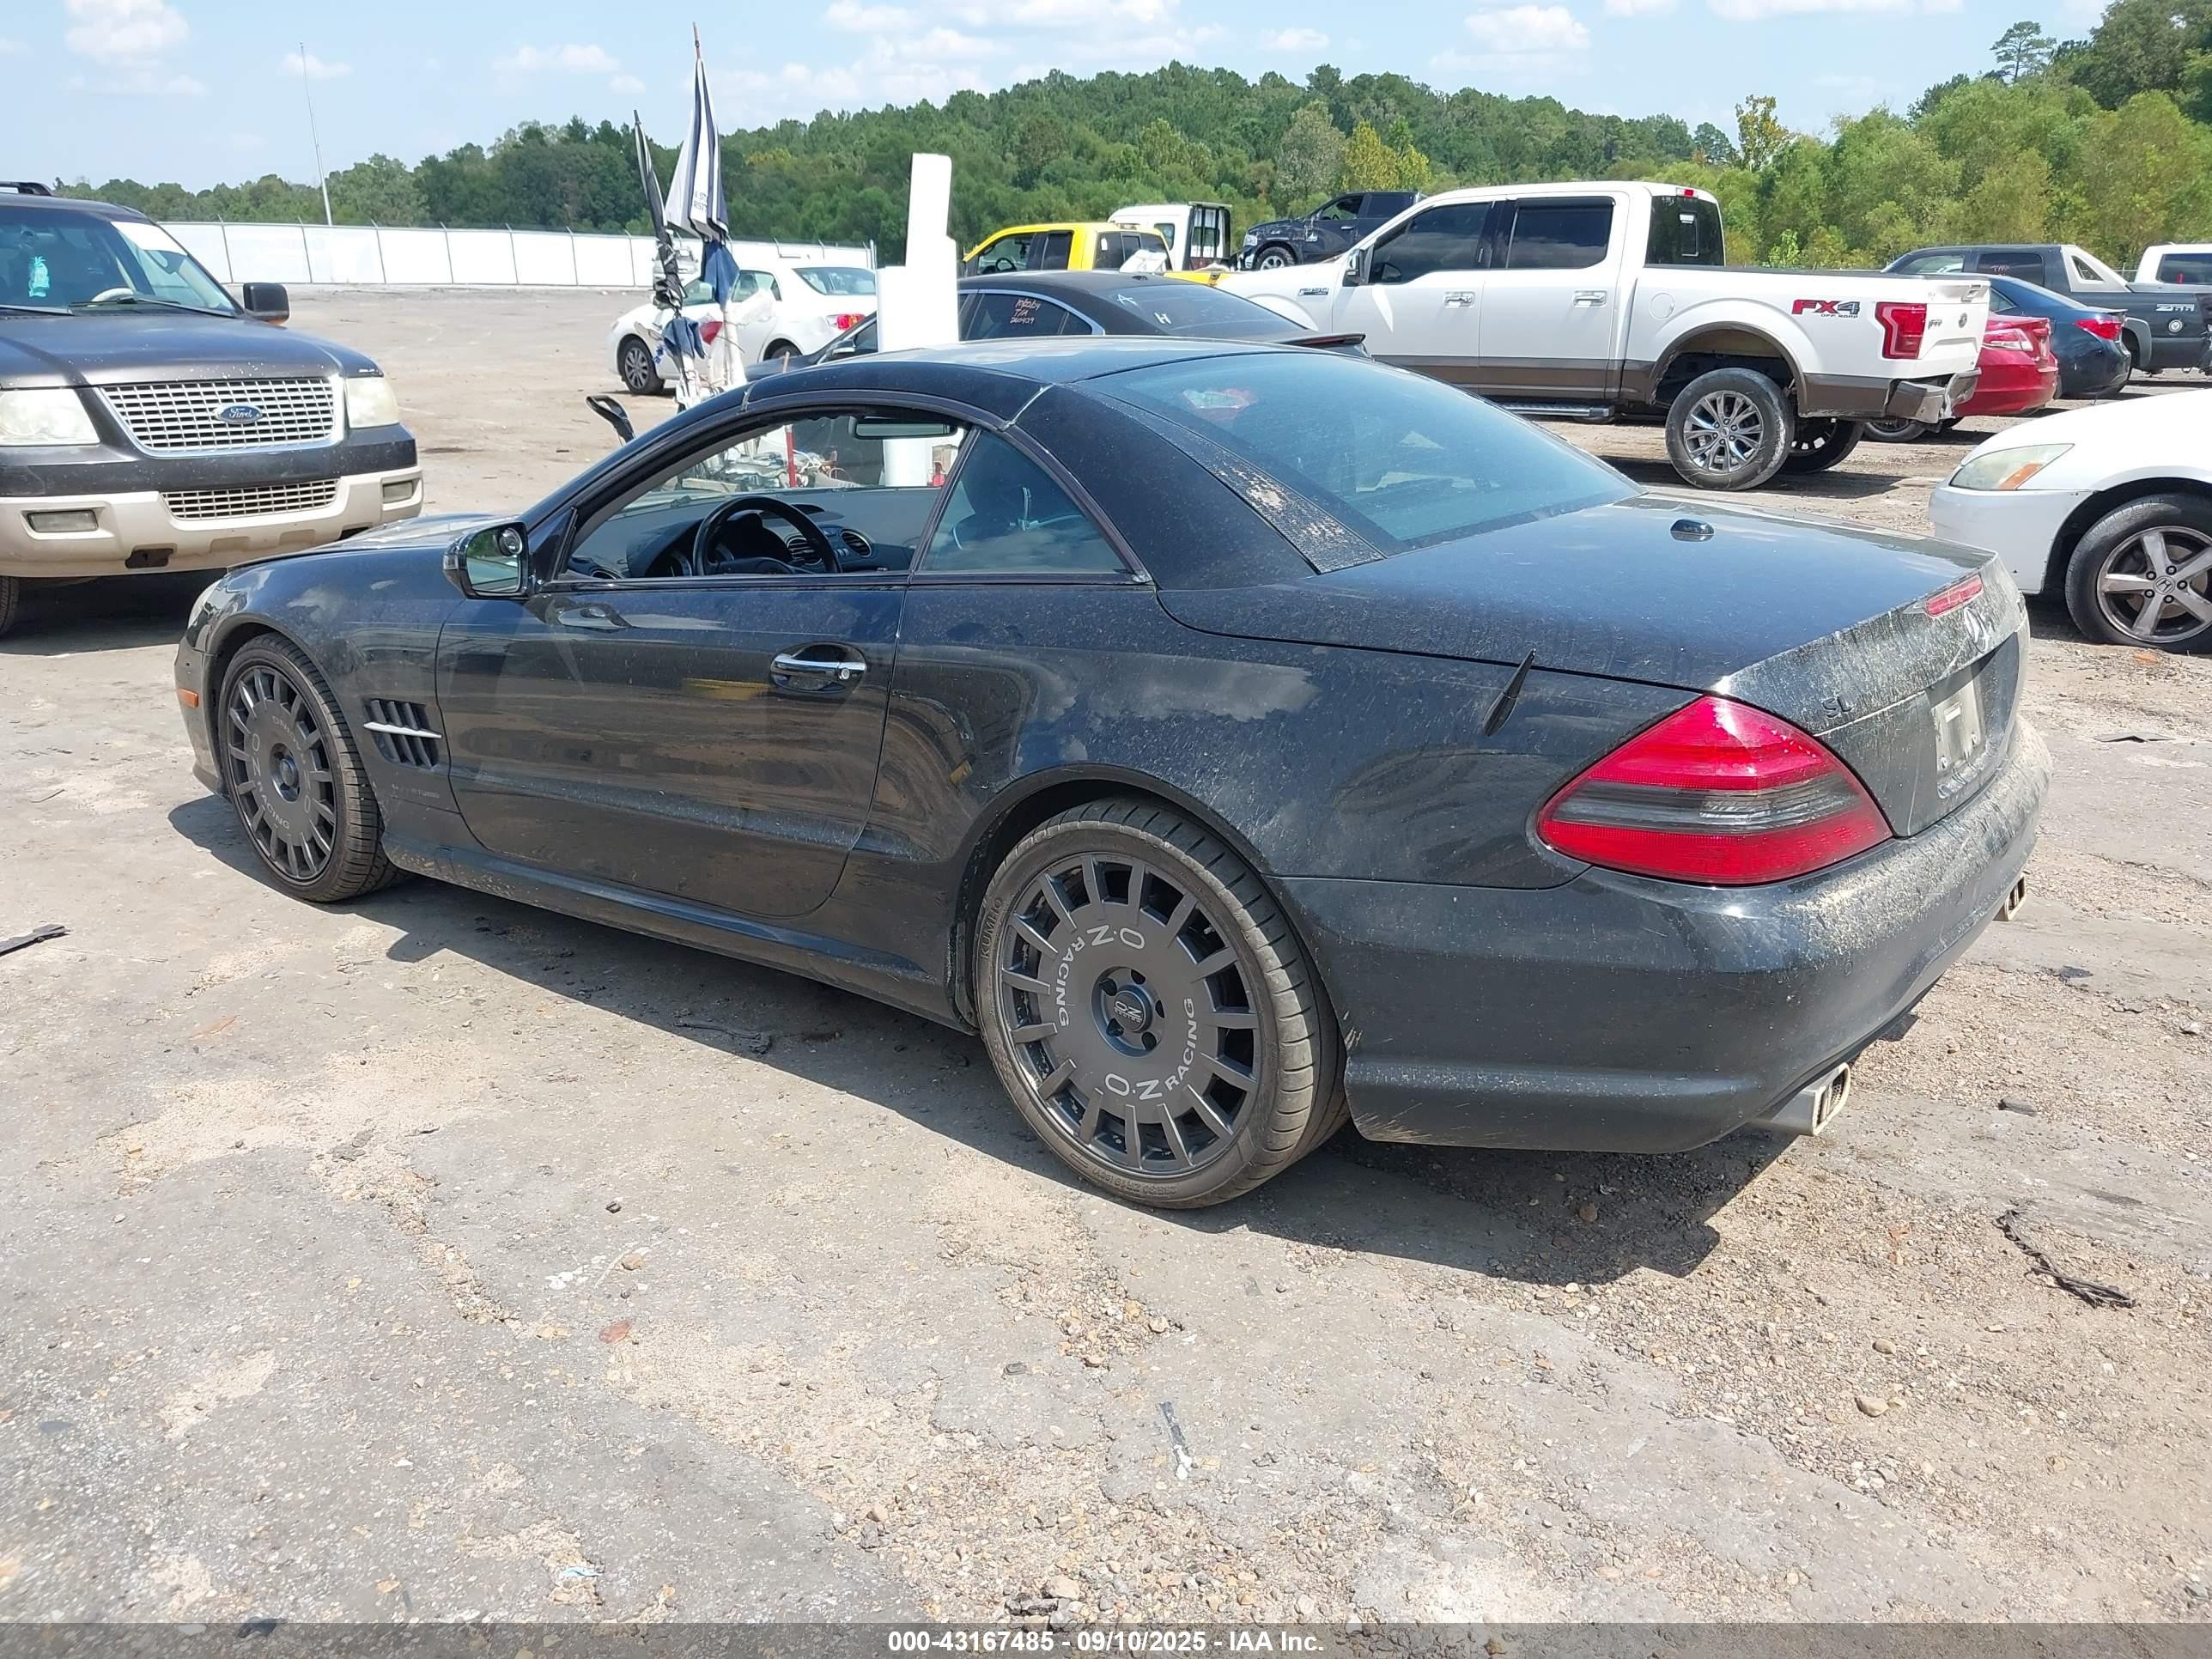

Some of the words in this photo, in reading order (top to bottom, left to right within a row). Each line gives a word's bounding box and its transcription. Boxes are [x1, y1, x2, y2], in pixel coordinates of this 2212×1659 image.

[1791, 299, 1861, 315] FX4
[229, 408, 252, 419] Ford
[1821, 696, 1854, 719] SL
[981, 897, 1003, 959] KUMHO
[1055, 936, 1085, 1027] RACING
[1164, 998, 1197, 1091] RACING
